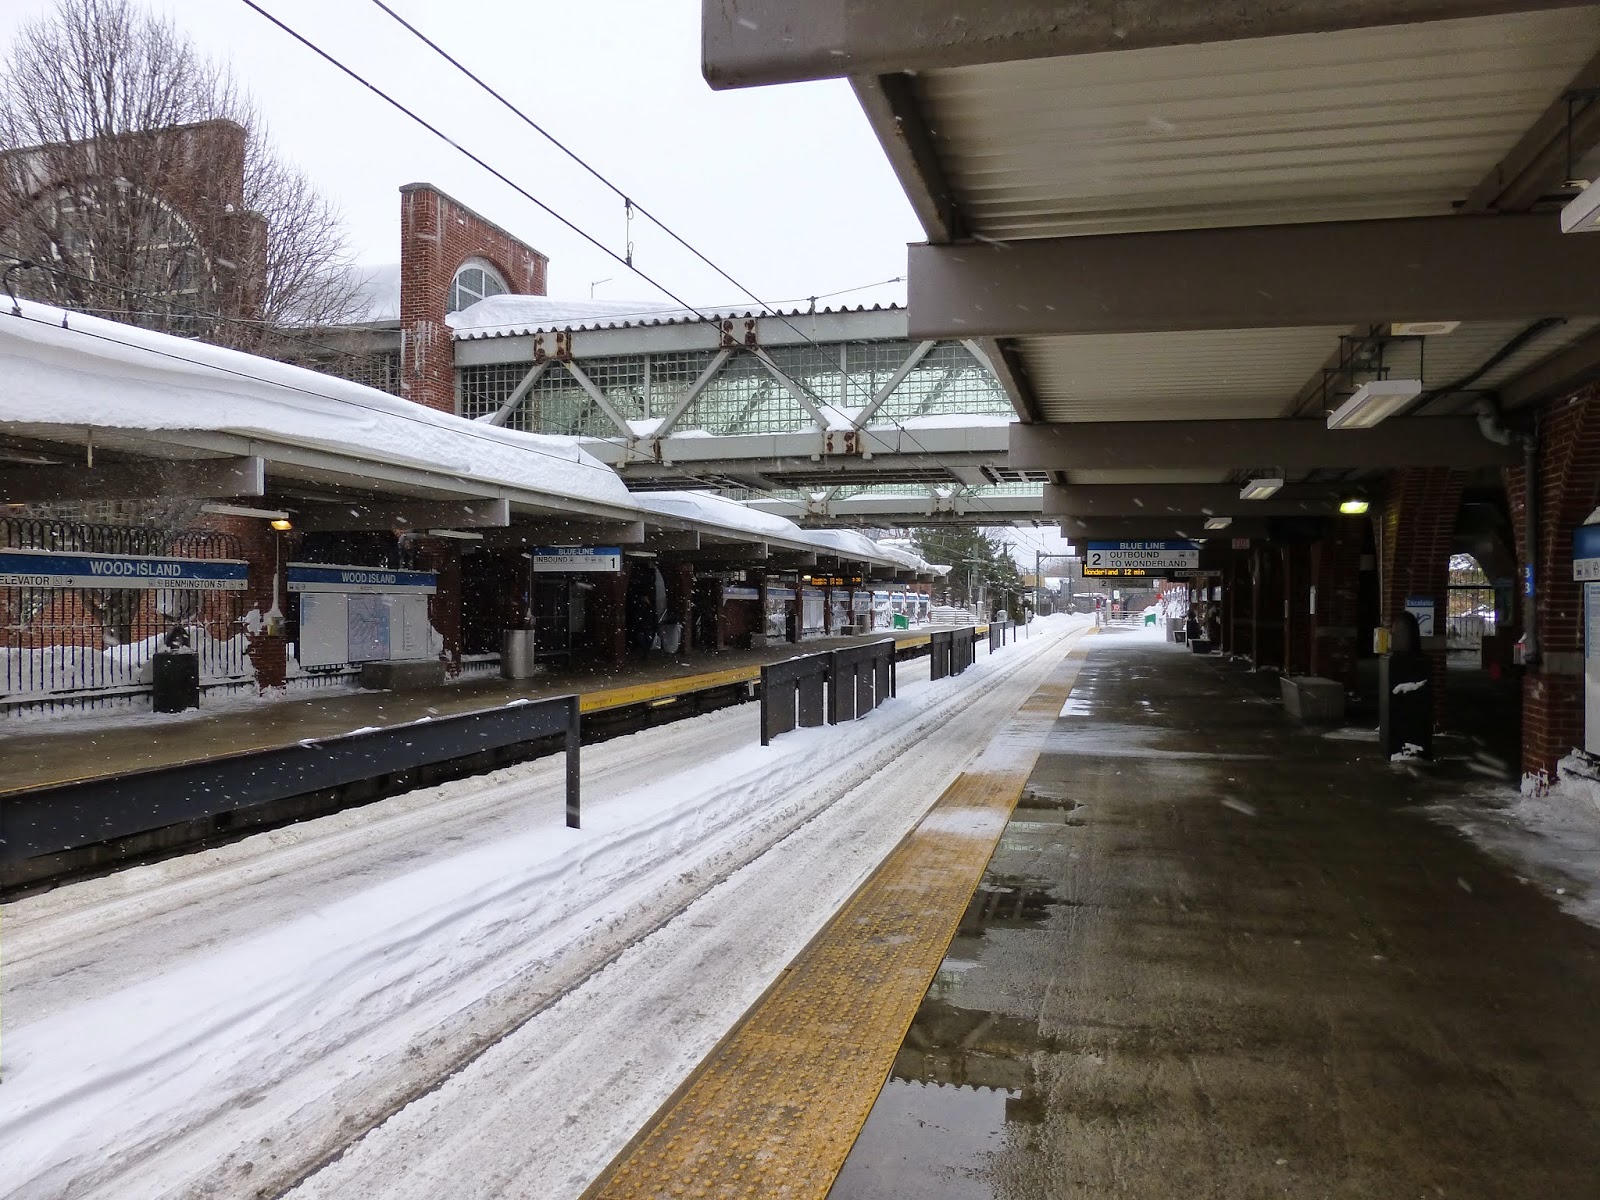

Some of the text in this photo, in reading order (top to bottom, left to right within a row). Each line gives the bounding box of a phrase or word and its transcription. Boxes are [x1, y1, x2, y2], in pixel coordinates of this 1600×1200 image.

[558, 547, 595, 555] BLUE LINE
[1109, 551, 1160, 559] OUTBOUND
[609, 557, 616, 569] 1
[1091, 553, 1102, 566] 2
[1109, 560, 1187, 568] TO WONDERLAND
[89, 560, 181, 576] WOOD ISLAND
[1083, 568, 1146, 576] Wonderland 12 min
[0, 575, 50, 586] ELEVATOR
[341, 572, 397, 584] WOOD ISLAND
[164, 579, 216, 588] BENNINGTON
